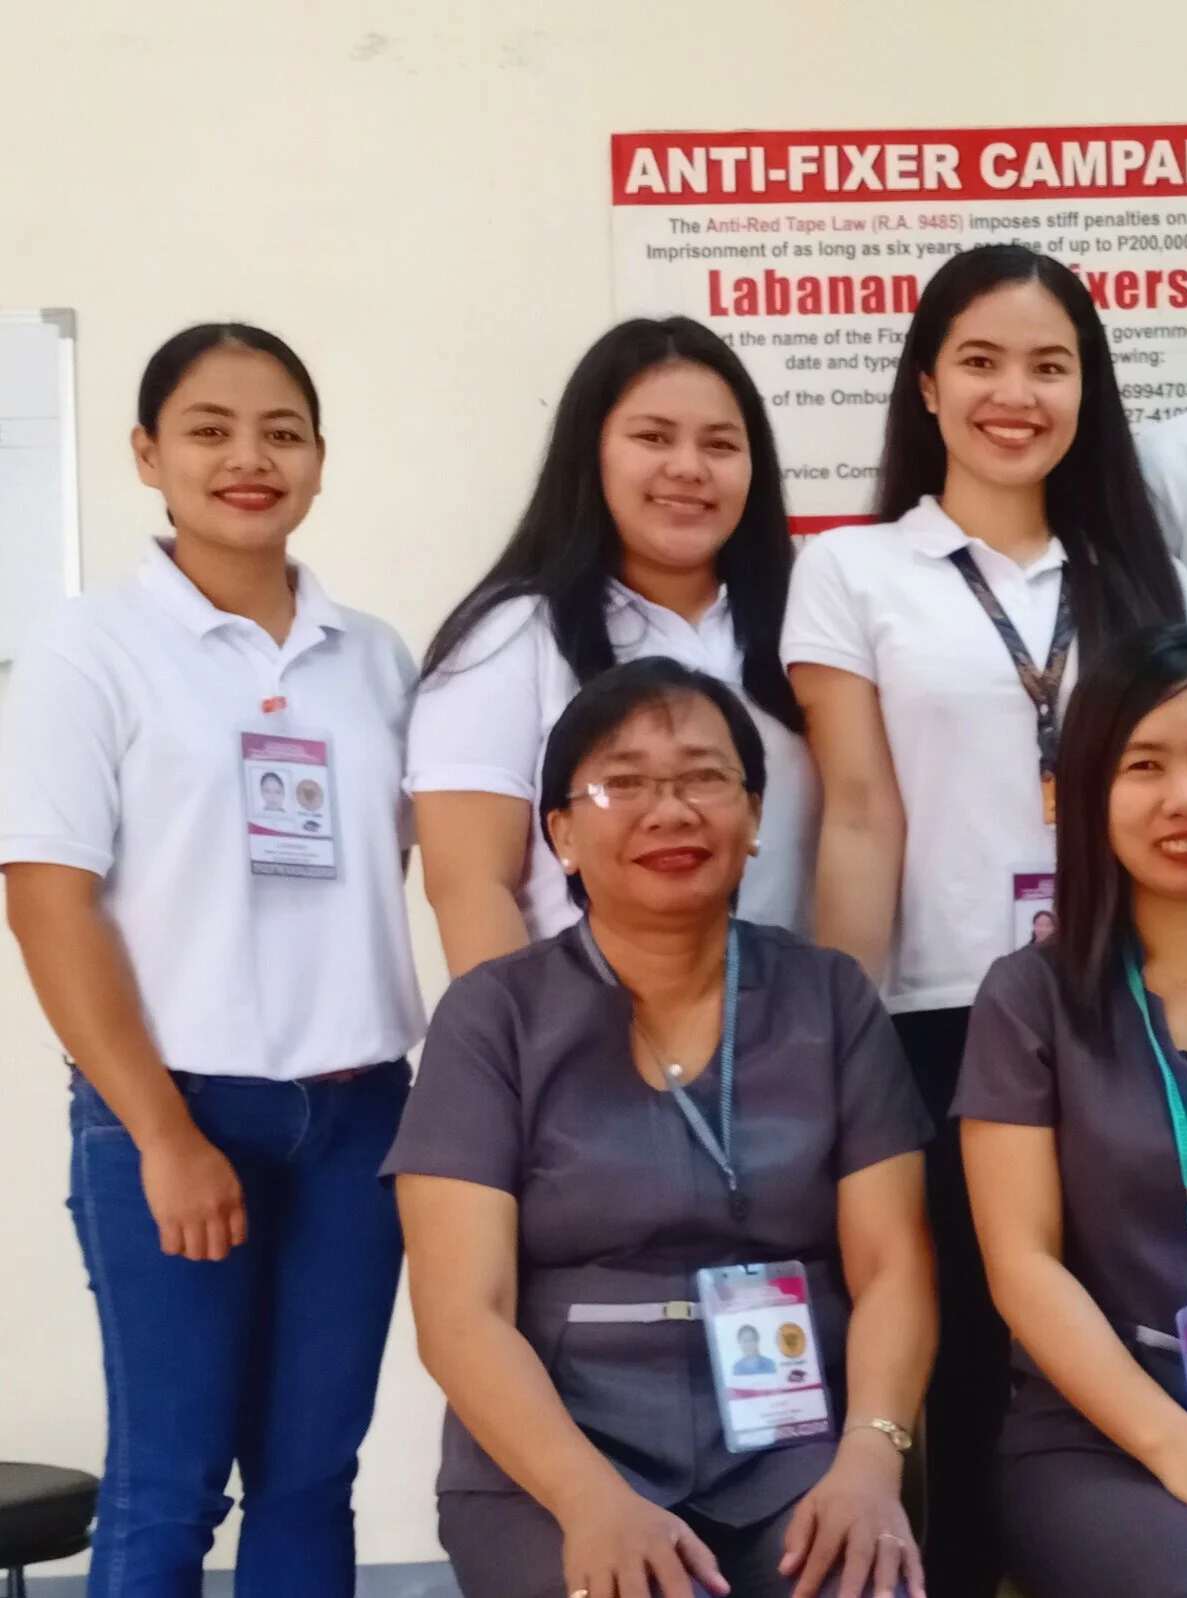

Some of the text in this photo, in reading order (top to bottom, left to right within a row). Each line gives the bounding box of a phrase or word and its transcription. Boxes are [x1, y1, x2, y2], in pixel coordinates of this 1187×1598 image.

[624, 143, 962, 194] ANTI-FIXER
[668, 217, 700, 233] The
[706, 215, 780, 233] Anti-Red
[785, 215, 826, 235] Tape
[832, 215, 866, 232] Law
[918, 214, 964, 234] 9485)
[969, 213, 1041, 233] imposes
[1046, 211, 1079, 228] stiff
[1084, 211, 1160, 232] penalties
[1166, 212, 1187, 225] on
[646, 242, 766, 262] Imprisonment
[771, 241, 789, 257] of
[793, 244, 813, 257] as
[818, 240, 857, 261] long
[862, 243, 881, 257] as
[886, 239, 911, 256] six
[1047, 236, 1064, 253] of
[1069, 239, 1091, 255] up
[1096, 236, 1112, 252] to
[709, 269, 919, 316] Labanan
[740, 331, 766, 346] the
[772, 331, 818, 346] name
[823, 328, 841, 344] of
[846, 328, 872, 344] the
[785, 354, 822, 370] date
[827, 354, 859, 370] and
[772, 390, 790, 406] of
[795, 389, 825, 405] the
